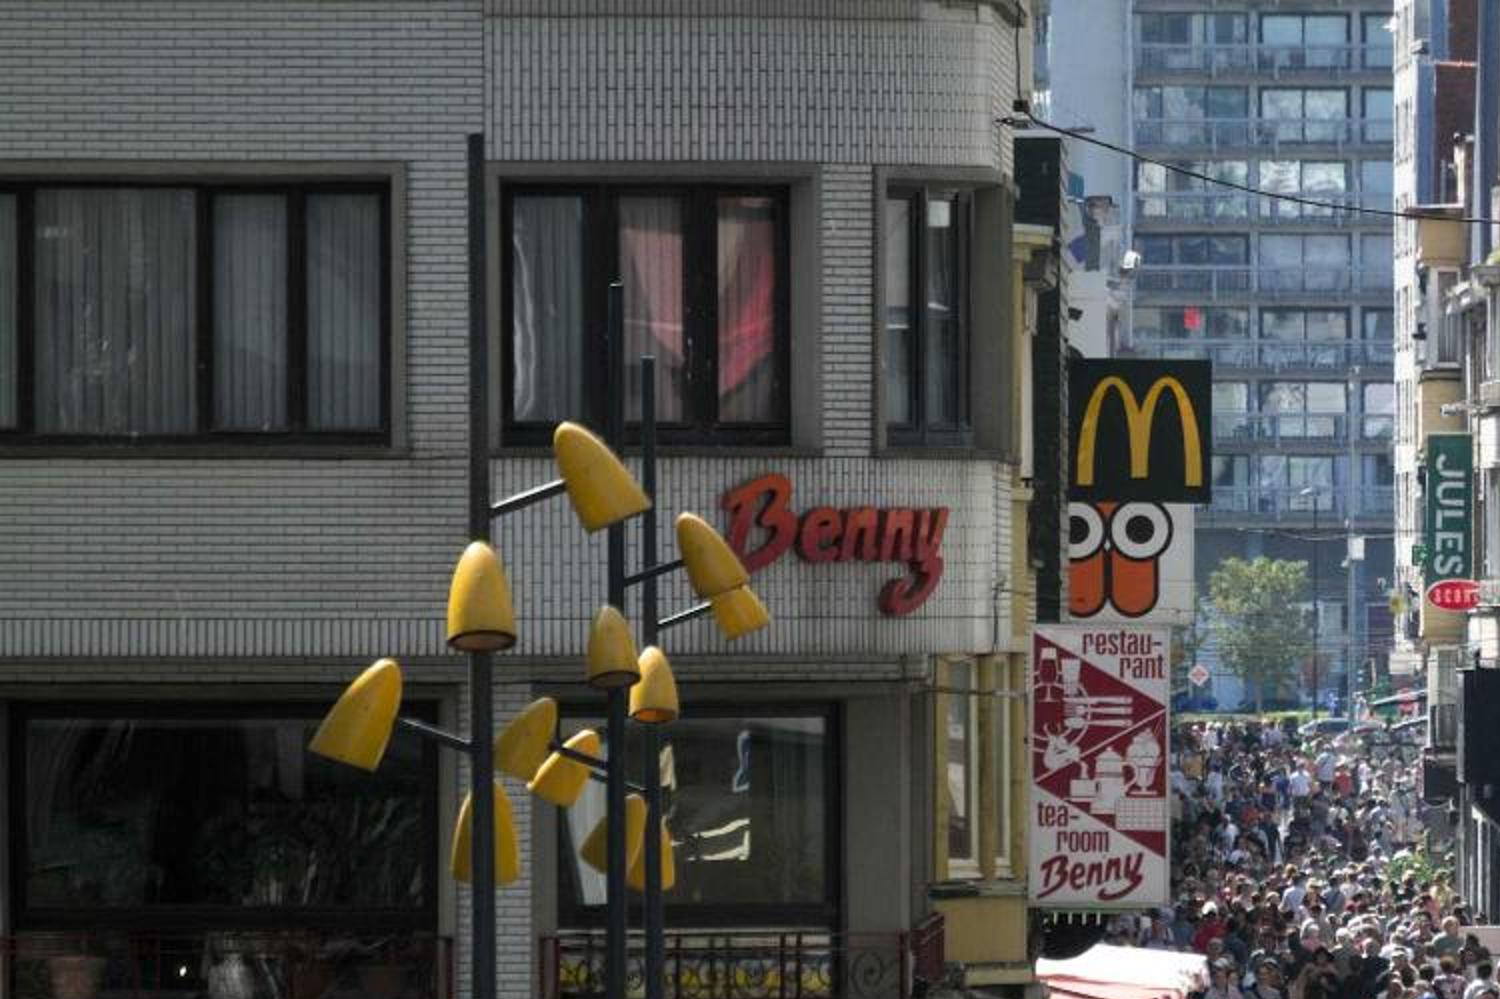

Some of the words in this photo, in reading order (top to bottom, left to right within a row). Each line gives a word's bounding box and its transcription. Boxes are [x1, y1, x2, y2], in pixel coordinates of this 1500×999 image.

[1434, 453, 1466, 575] JULES
[719, 472, 949, 617] Benny
[1081, 630, 1163, 656] restau-
[1119, 656, 1165, 679] rant
[1037, 802, 1079, 827] tea-
[1056, 831, 1110, 853] room
[1036, 852, 1144, 900] Benny
